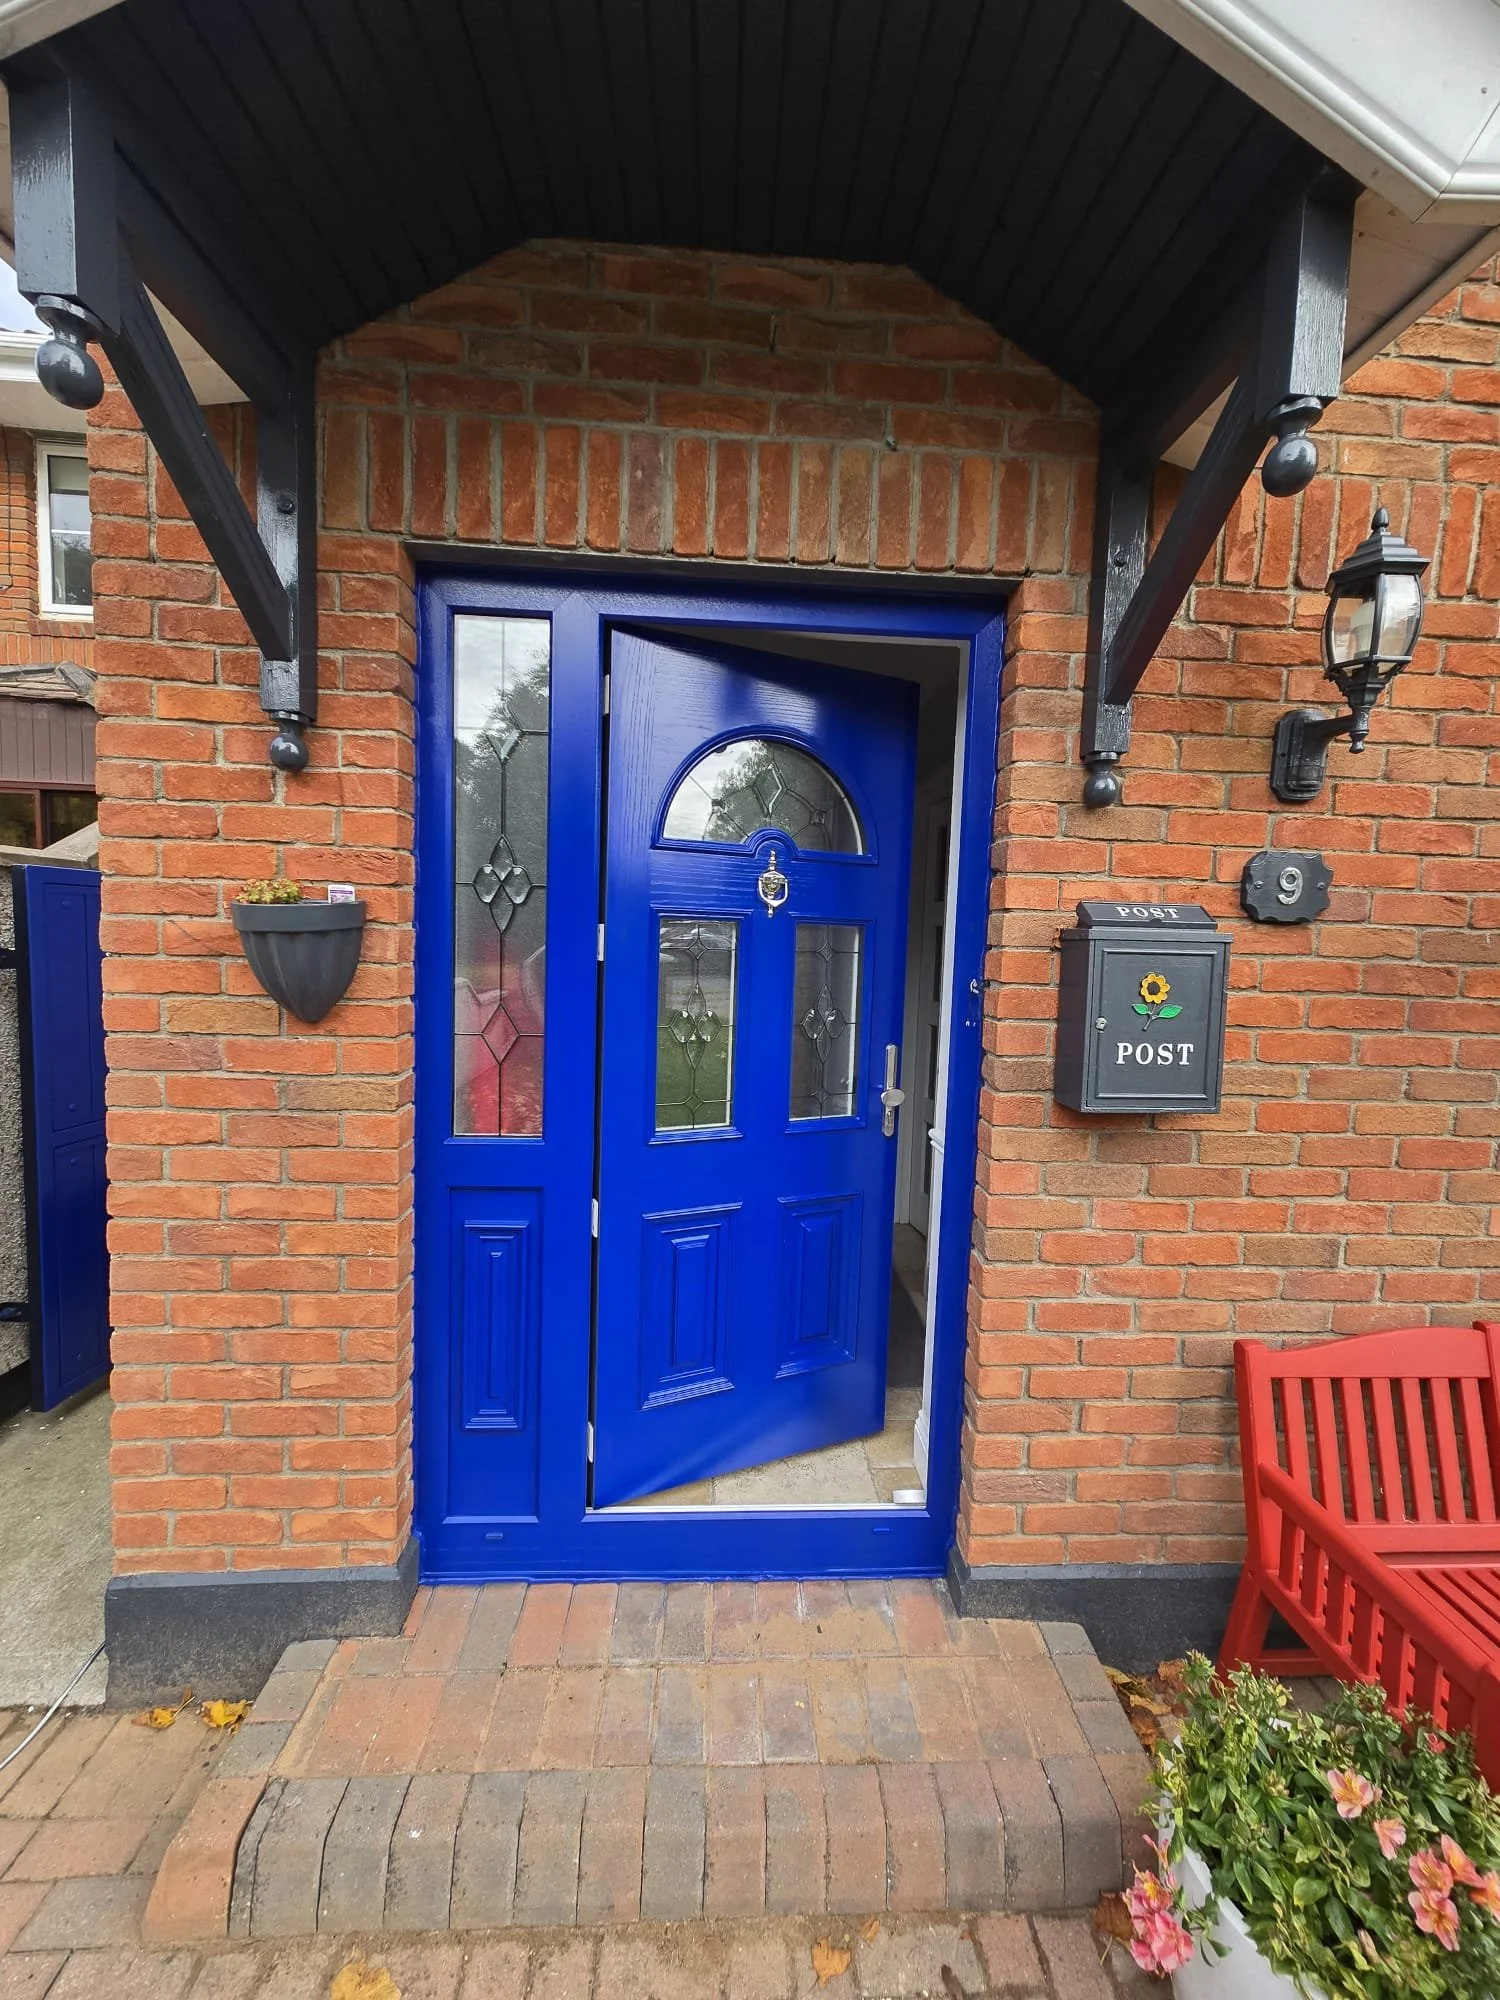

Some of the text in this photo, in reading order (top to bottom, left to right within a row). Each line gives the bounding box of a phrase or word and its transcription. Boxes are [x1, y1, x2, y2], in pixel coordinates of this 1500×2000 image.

[1276, 867, 1304, 905] 9
[1115, 906, 1180, 919] POST
[1115, 1042, 1194, 1066] POST
